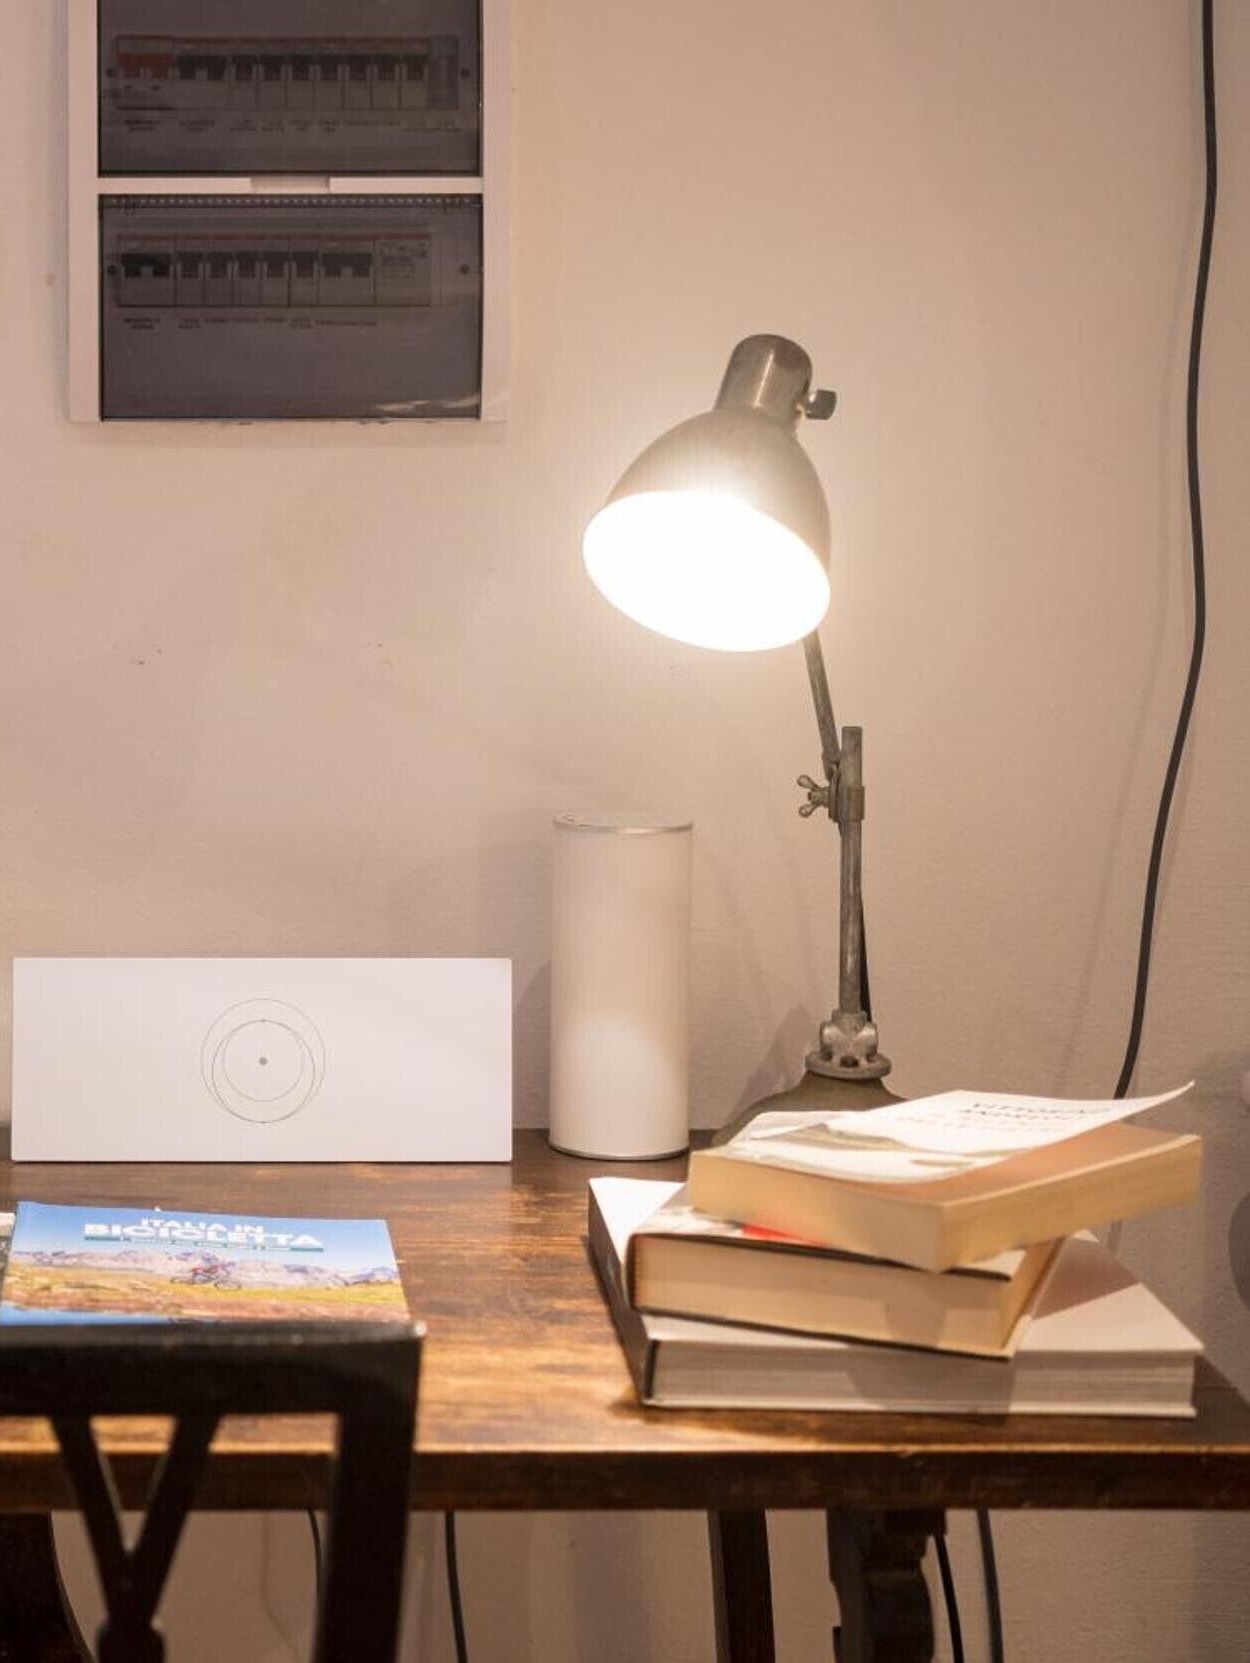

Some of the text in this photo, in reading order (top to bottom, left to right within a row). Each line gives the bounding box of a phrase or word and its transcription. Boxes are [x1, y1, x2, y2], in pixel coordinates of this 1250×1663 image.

[83, 1223, 324, 1247] BICICLETTA
[141, 1218, 265, 1234] ITALIA IN
